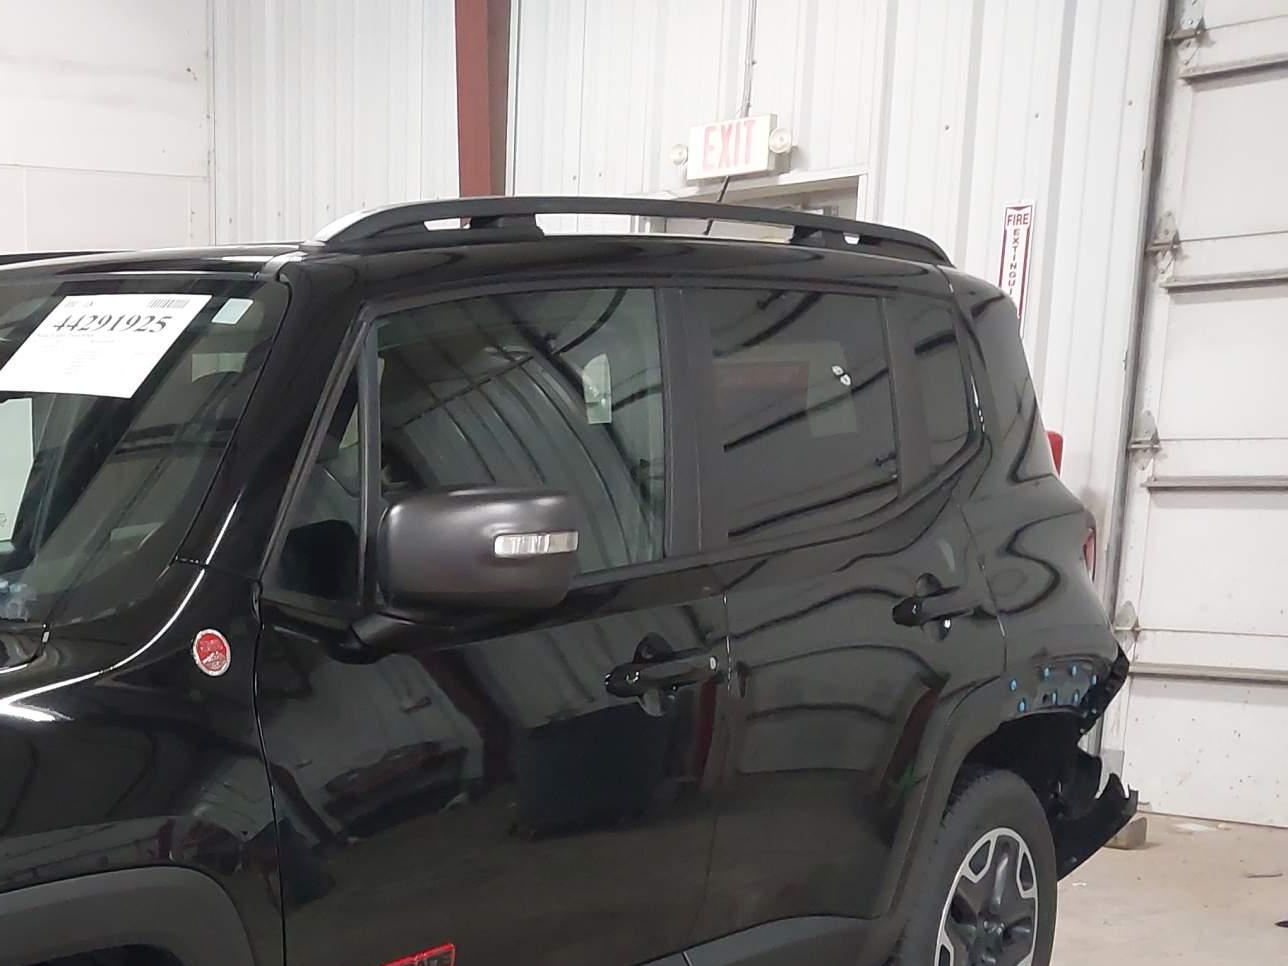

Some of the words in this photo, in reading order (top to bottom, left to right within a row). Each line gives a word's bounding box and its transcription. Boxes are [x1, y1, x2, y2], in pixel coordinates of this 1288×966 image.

[702, 119, 756, 173] EXIT
[1007, 213, 1029, 226] FIRE
[52, 314, 173, 333] 44291925
